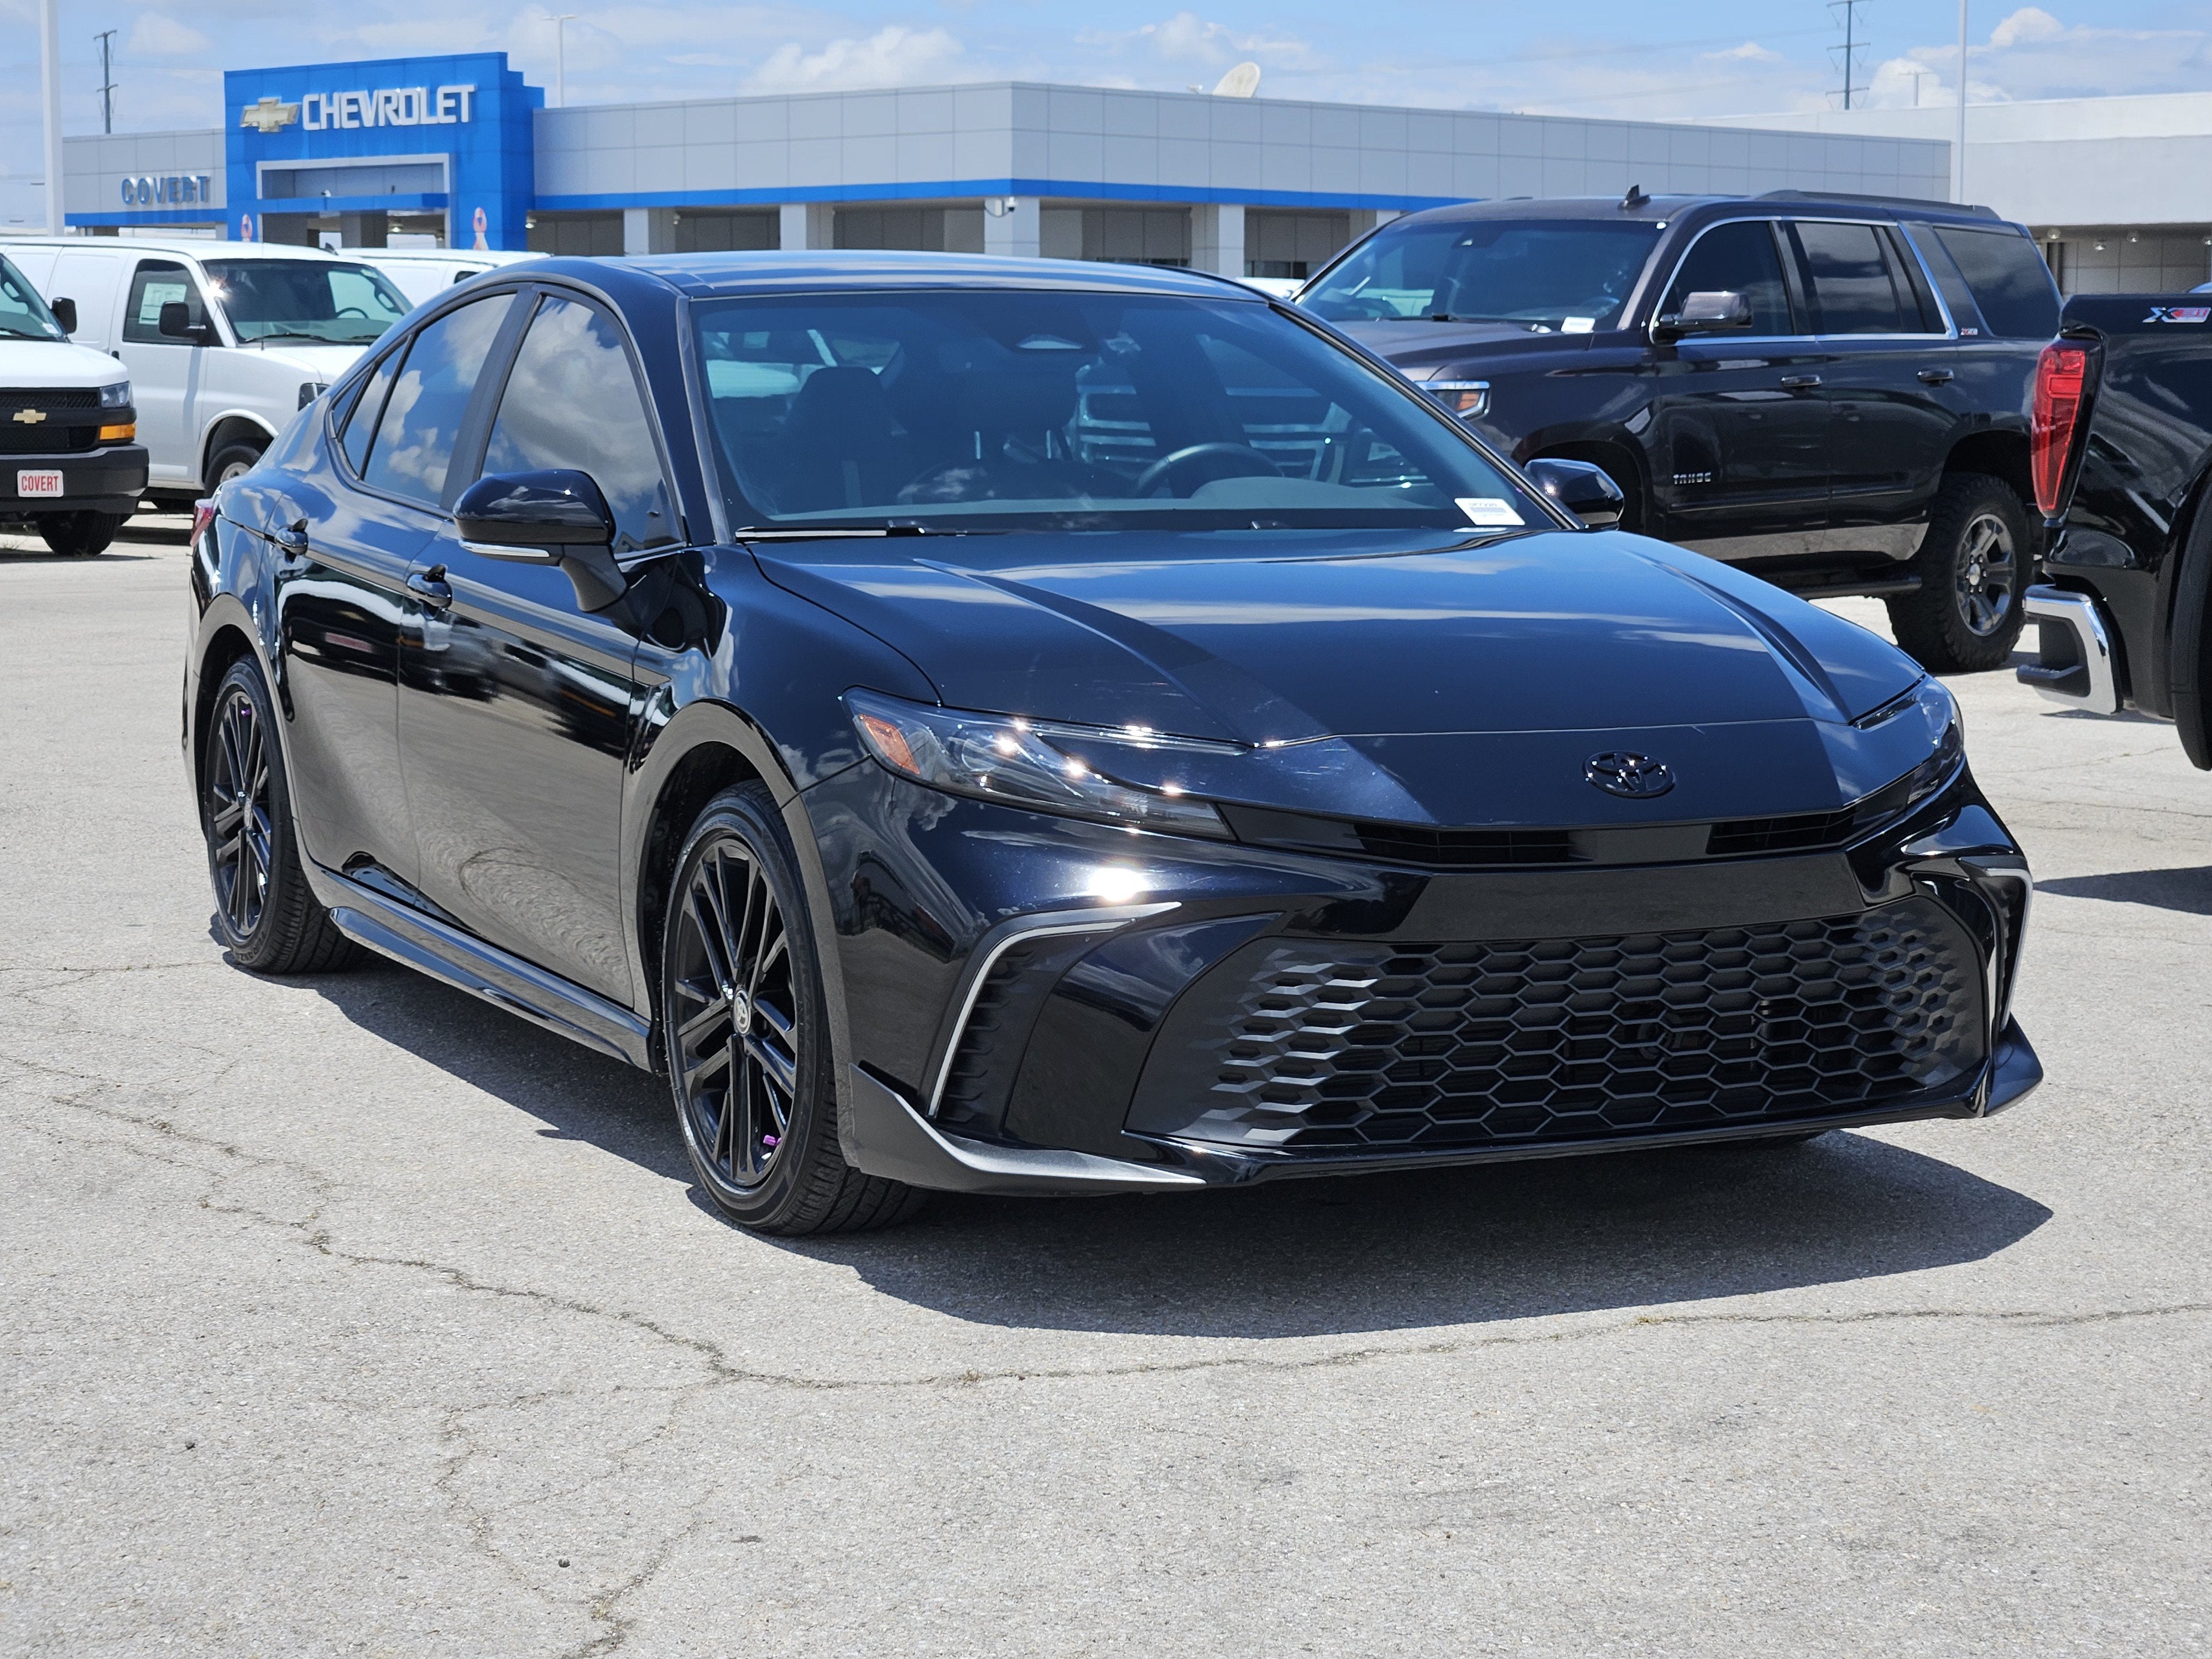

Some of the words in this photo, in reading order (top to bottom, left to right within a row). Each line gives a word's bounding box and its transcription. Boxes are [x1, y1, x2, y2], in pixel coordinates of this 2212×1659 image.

[302, 84, 475, 131] CHEVROLET
[121, 176, 210, 205] COVERT
[21, 475, 59, 492] COVERT
[1673, 472, 1711, 484] TAHOE
